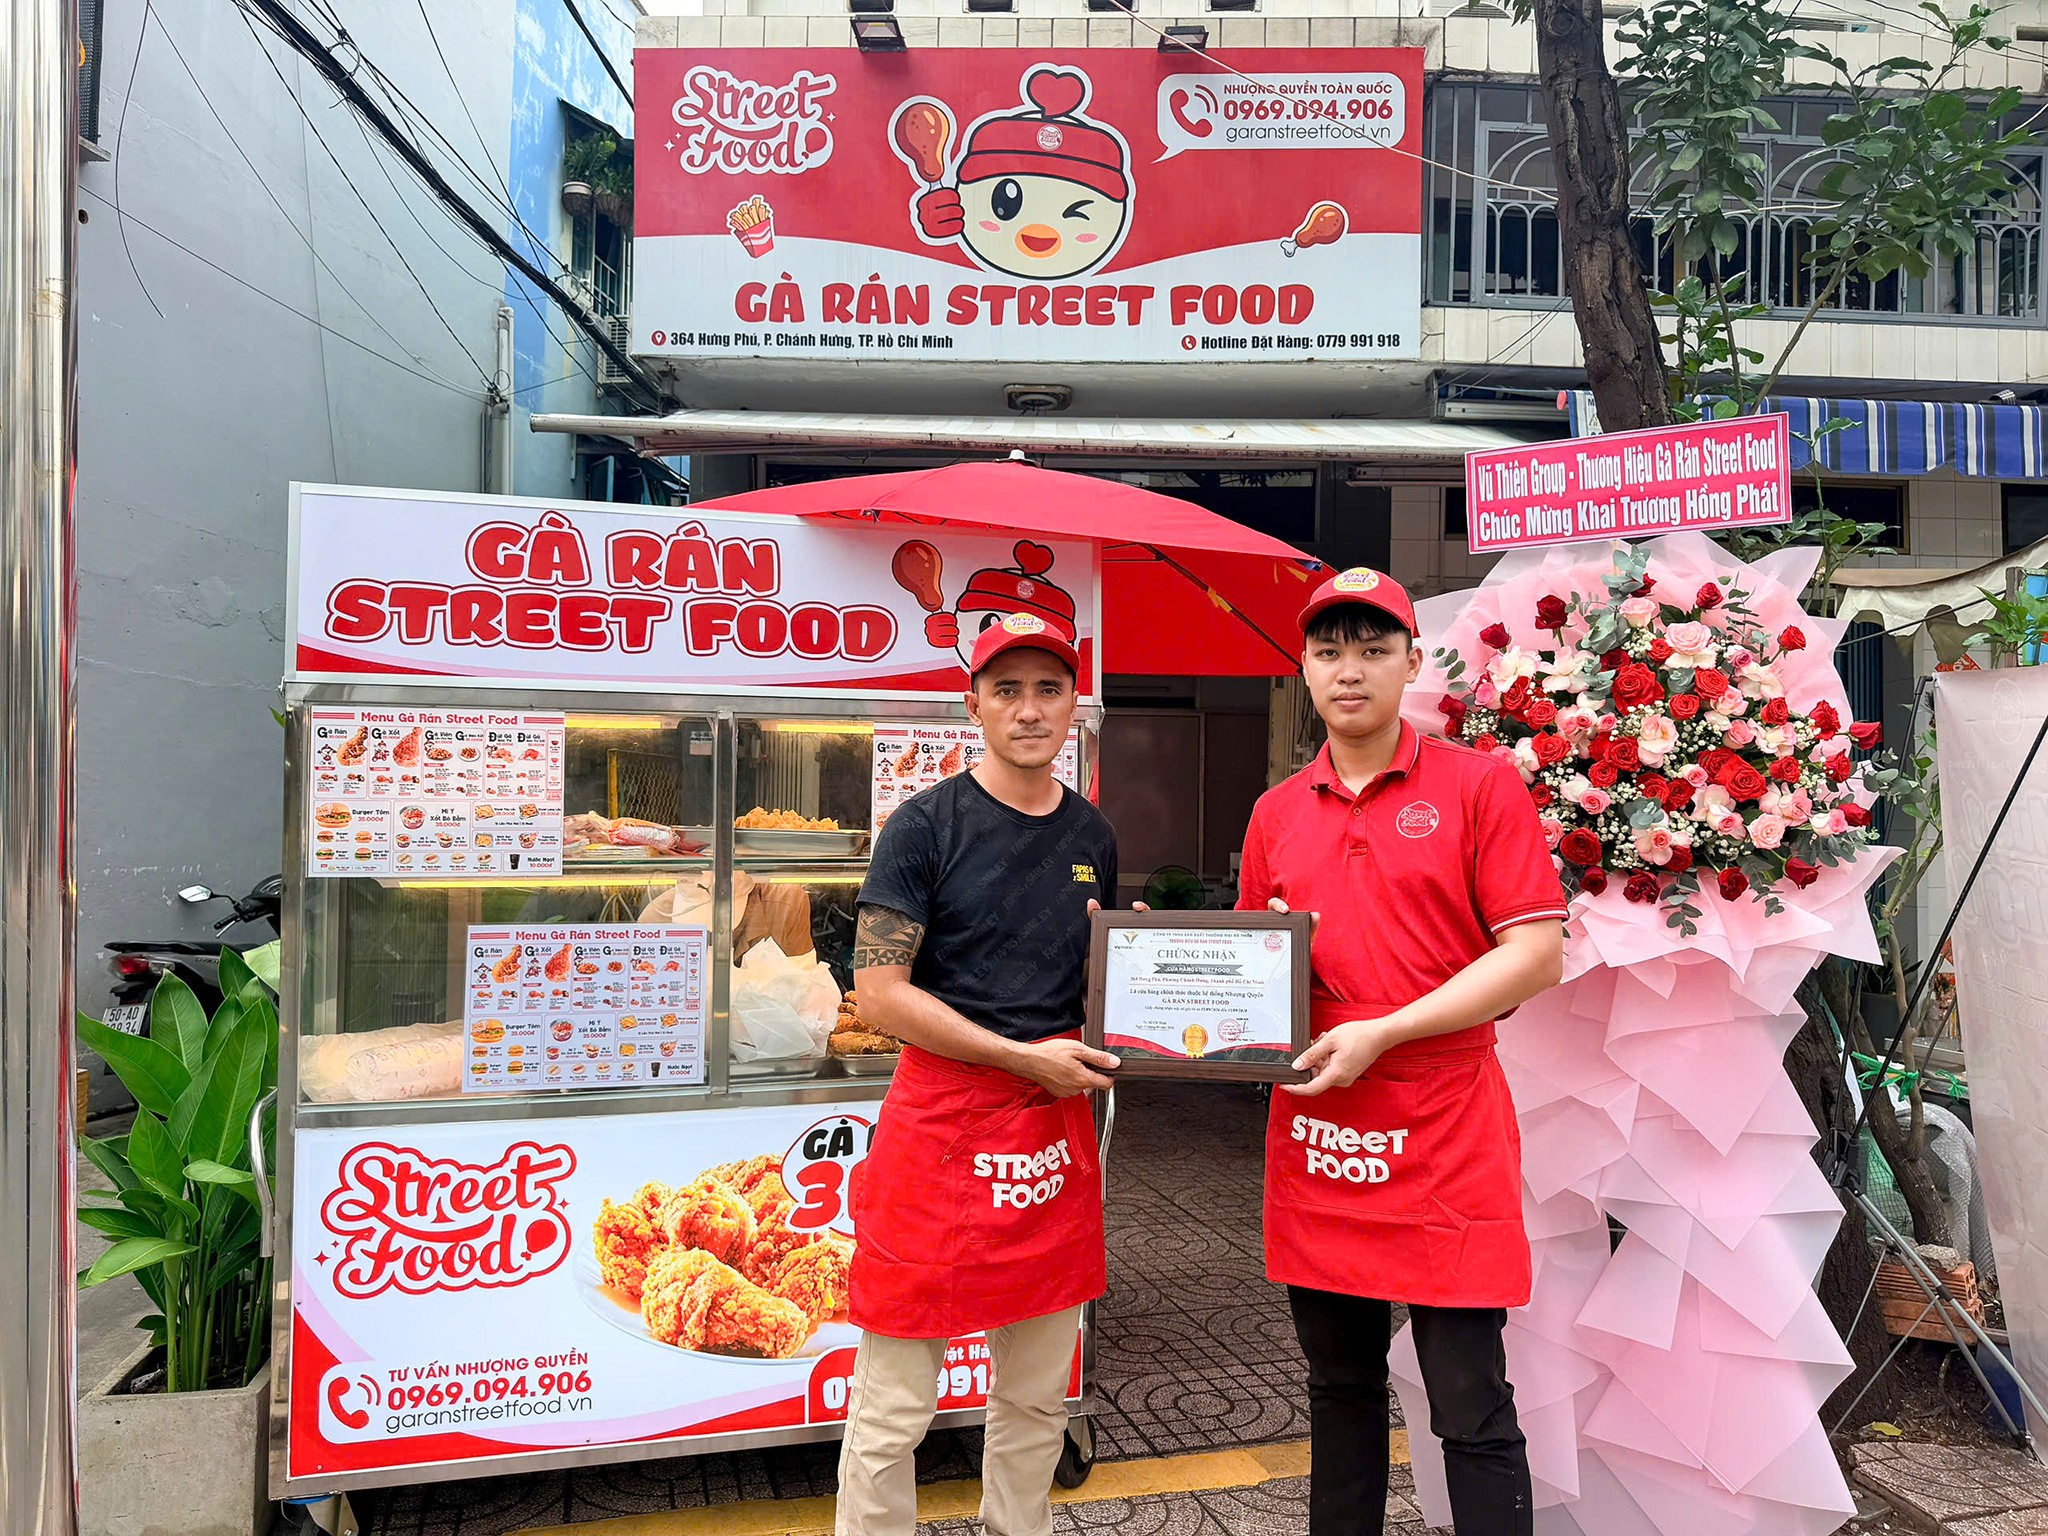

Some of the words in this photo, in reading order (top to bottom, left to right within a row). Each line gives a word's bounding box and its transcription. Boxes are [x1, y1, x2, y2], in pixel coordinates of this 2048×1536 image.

[679, 70, 831, 132] Street
[1223, 83, 1276, 98] NHƯỢNG
[1278, 79, 1319, 96] QUYỀN
[1320, 79, 1354, 95] TOÀN
[1356, 79, 1393, 95] QUỐC
[1223, 98, 1394, 121] 0969.094.906
[685, 121, 809, 169] Food
[734, 271, 806, 324] GÀ
[821, 271, 931, 325] RÁN
[946, 283, 1155, 327] STREET
[1169, 283, 1315, 327] FOOD
[670, 332, 695, 347] 364
[698, 332, 730, 349] Hưng
[734, 331, 761, 348] Phú,
[764, 333, 774, 347] P.
[776, 331, 817, 348] Chánh
[820, 332, 855, 350] Hưng,
[858, 333, 875, 348] TP.
[877, 331, 894, 348] Hồ
[897, 333, 918, 349] Chí
[922, 334, 953, 349] Minh
[1201, 335, 1249, 350] Hotline
[1251, 335, 1274, 352] Đặt
[1276, 334, 1314, 351] Hàng:
[1316, 334, 1348, 349] 0779
[1350, 334, 1374, 349] 991
[1376, 334, 1400, 348] 918
[1477, 463, 1494, 502] Vũ
[1495, 460, 1529, 501] Thiên
[1531, 457, 1567, 499] Group
[1576, 450, 1622, 492] Thương
[1624, 444, 1654, 492] Hiệu
[1656, 441, 1673, 482] Gà
[1674, 438, 1701, 479] Rán
[1702, 434, 1743, 478] Street
[1744, 429, 1777, 473] Food
[1478, 507, 1522, 543] Chúc
[1525, 502, 1573, 539] Mừng
[1576, 497, 1617, 532] Khai
[1620, 493, 1681, 527] Trương
[1686, 483, 1732, 522] Hồng
[1737, 481, 1780, 516] Phát
[466, 511, 590, 586] GÀ
[606, 521, 780, 596] RÁN
[326, 579, 672, 652] STREET
[684, 601, 898, 662] FOOD
[361, 711, 394, 724] Menu
[398, 710, 415, 724] Gà
[418, 712, 442, 724] Rán
[446, 713, 484, 725] Street
[488, 714, 518, 726] Food
[913, 729, 940, 739] Menu
[944, 730, 957, 739] Gà
[960, 730, 979, 740] Rán
[516, 931, 547, 940] Menu
[550, 930, 566, 940] Gà
[570, 930, 591, 940] Rán
[595, 930, 630, 940] Street
[633, 930, 661, 939] Food
[1157, 948, 1200, 959] CHỨNG
[1202, 950, 1236, 962] NHẬN
[802, 1118, 854, 1161] GÀ
[1305, 1147, 1390, 1184] FOOD
[336, 1154, 563, 1236] Street
[991, 1173, 1065, 1210] FOOD
[348, 1213, 525, 1286] Food
[388, 1364, 411, 1383] TƯ
[413, 1360, 451, 1380] VẤN
[455, 1355, 530, 1380] NHƯỢNG
[534, 1347, 589, 1371] QUYỀN
[946, 1343, 965, 1364] ặt
[387, 1369, 593, 1411] 0969.094.906
